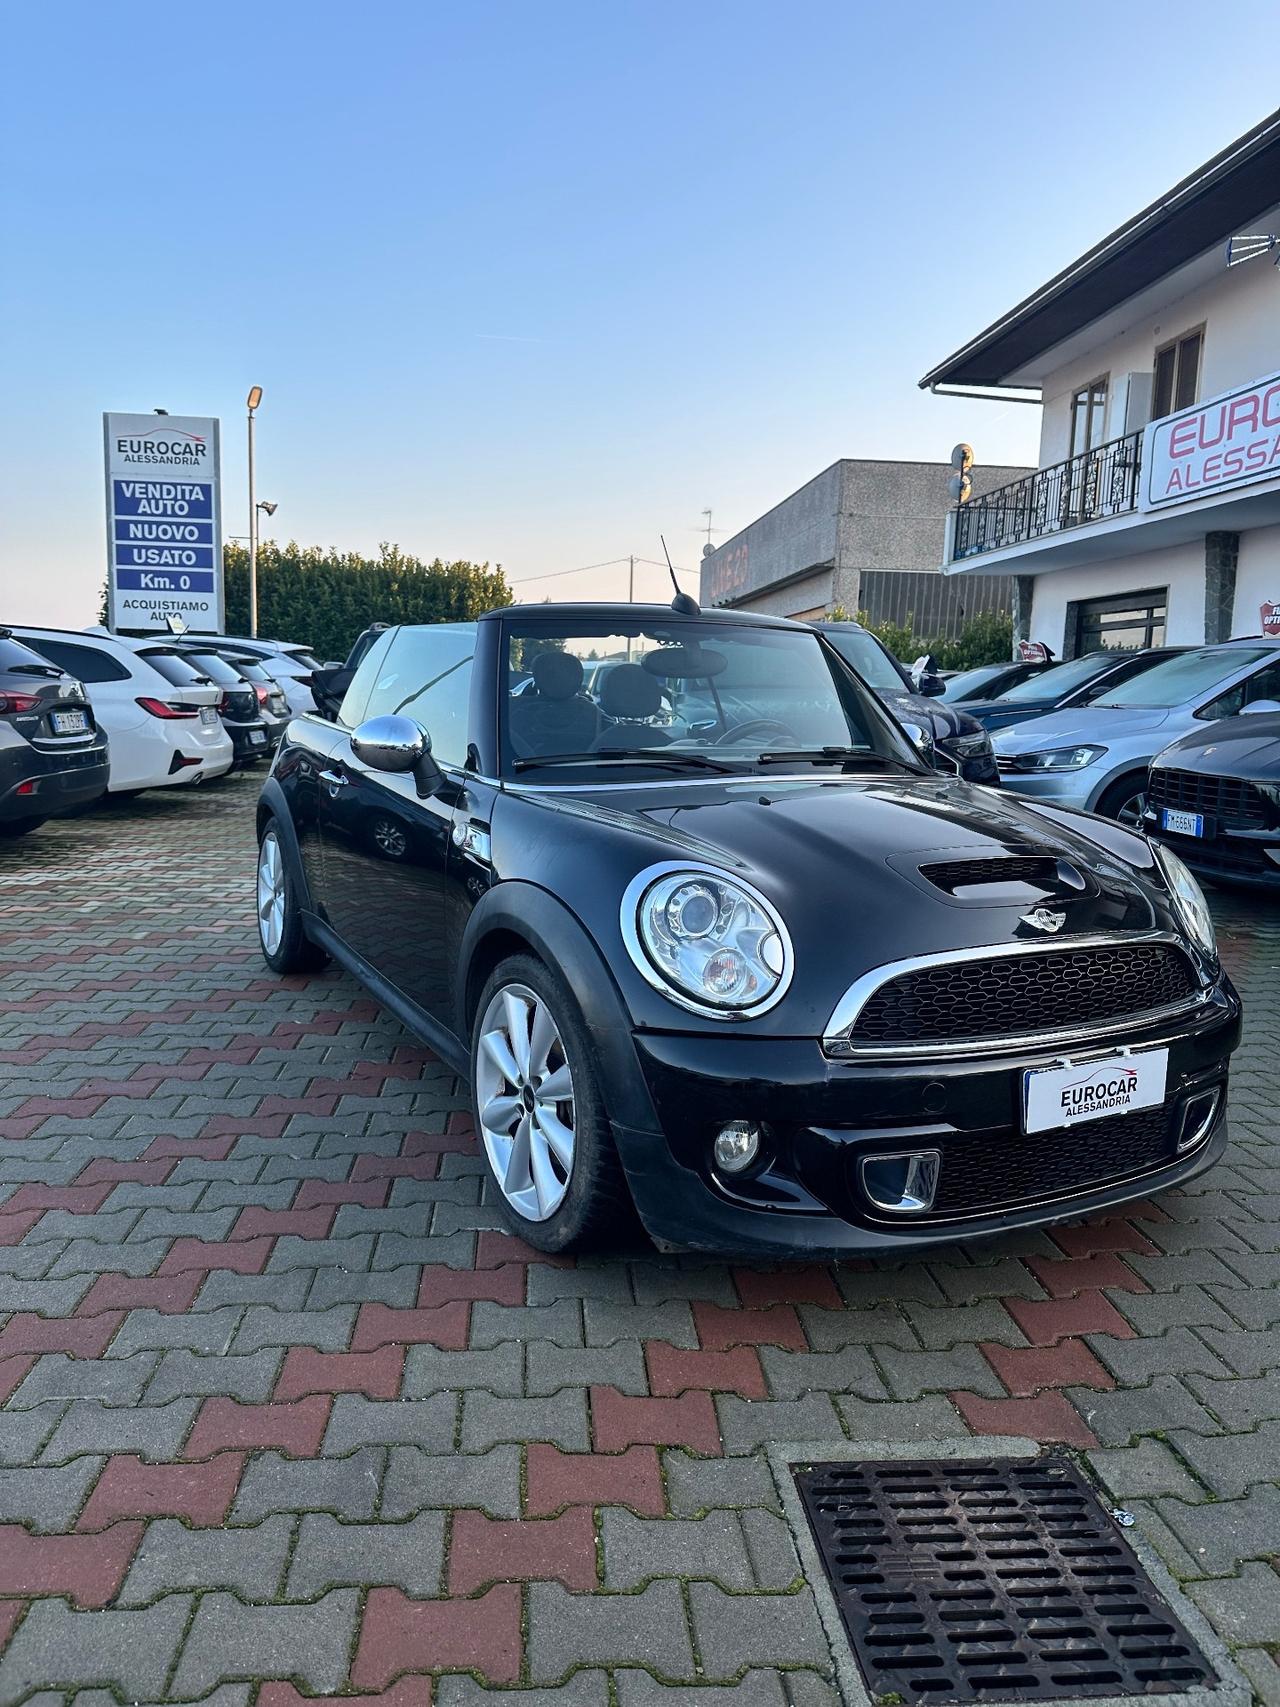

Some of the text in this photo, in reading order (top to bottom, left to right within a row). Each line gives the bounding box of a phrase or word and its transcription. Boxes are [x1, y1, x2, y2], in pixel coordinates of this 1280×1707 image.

[117, 439, 207, 457] EUROCAR
[123, 454, 201, 466] ALESSANDRIA
[120, 482, 205, 501] VENDITA
[137, 500, 189, 515] AUTO
[129, 523, 199, 541] NUOVO
[132, 548, 197, 565] USATO
[140, 573, 191, 590] Km. 0
[122, 599, 209, 612] ACQUISTIAMO
[1060, 1077, 1138, 1107] EUROCAR
[1065, 1094, 1131, 1117] ALESSANDRIA
